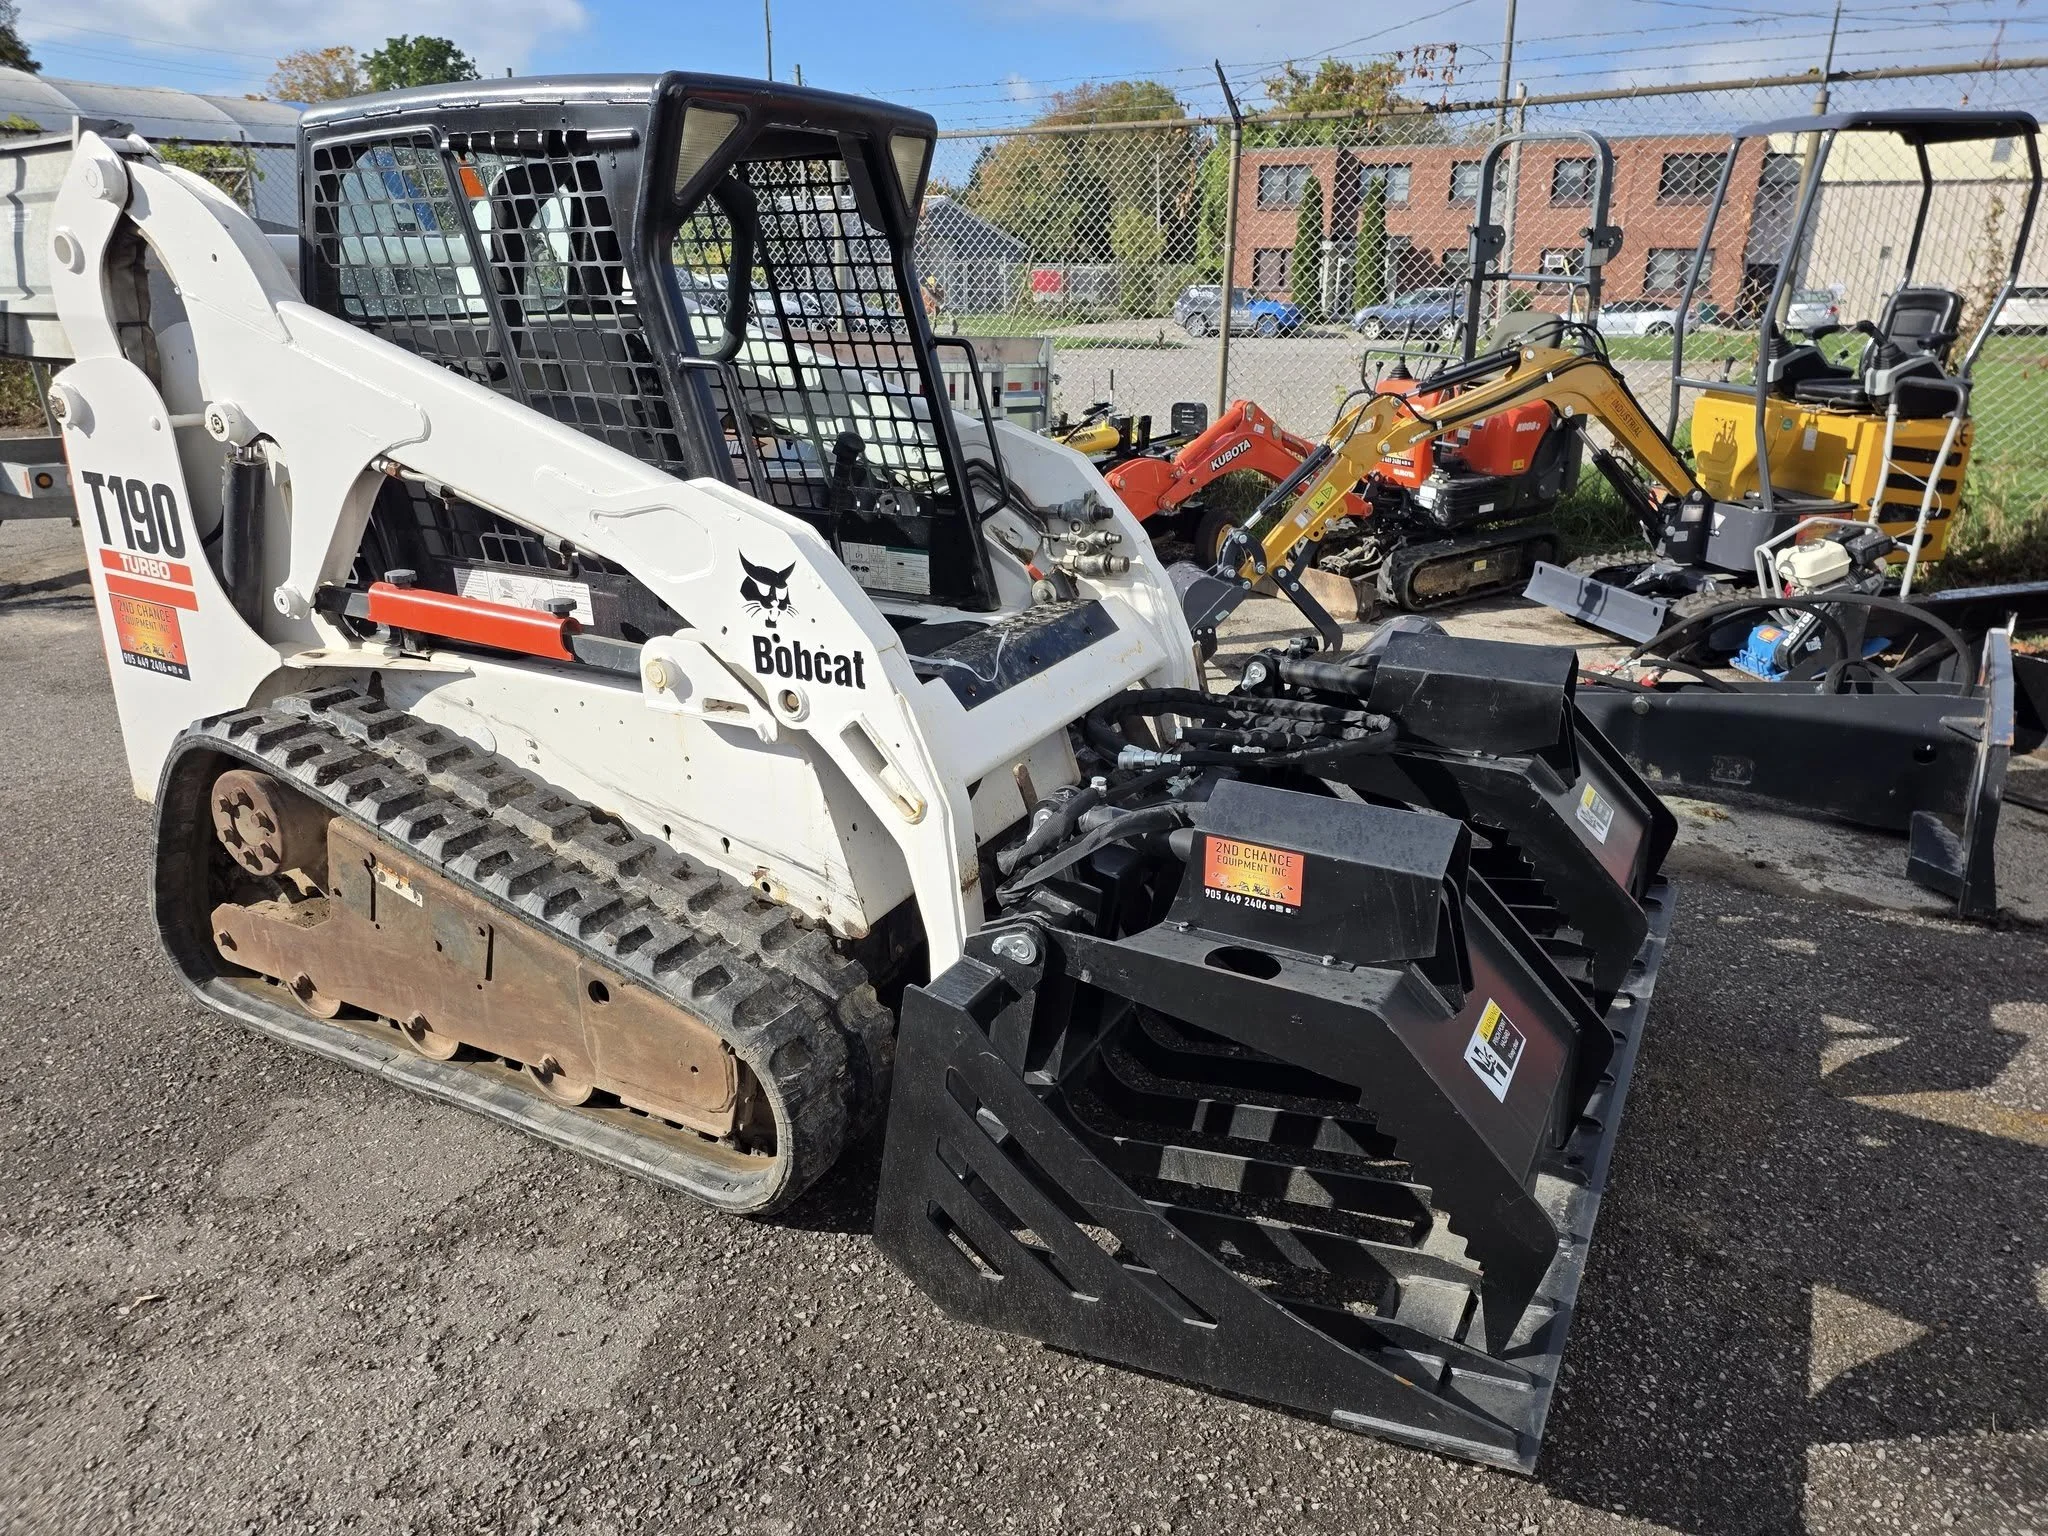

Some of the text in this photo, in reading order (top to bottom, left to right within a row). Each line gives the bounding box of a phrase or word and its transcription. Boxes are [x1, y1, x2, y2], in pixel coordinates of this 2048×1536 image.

[1612, 400, 1642, 437] INDUSTRIAL
[1210, 439, 1252, 472] KUBOTA
[82, 471, 186, 559] T190
[119, 554, 171, 580] TURBO
[117, 599, 171, 622] 2ND CHANCE
[123, 652, 136, 665] 905
[137, 655, 149, 668] 449
[752, 635, 866, 690] Bobcat
[1216, 841, 1294, 868] 2ND CHANCE
[1217, 855, 1268, 873] EQUIPMENT
[1271, 866, 1288, 878] INC
[1204, 888, 1267, 911] 905 449 2406
